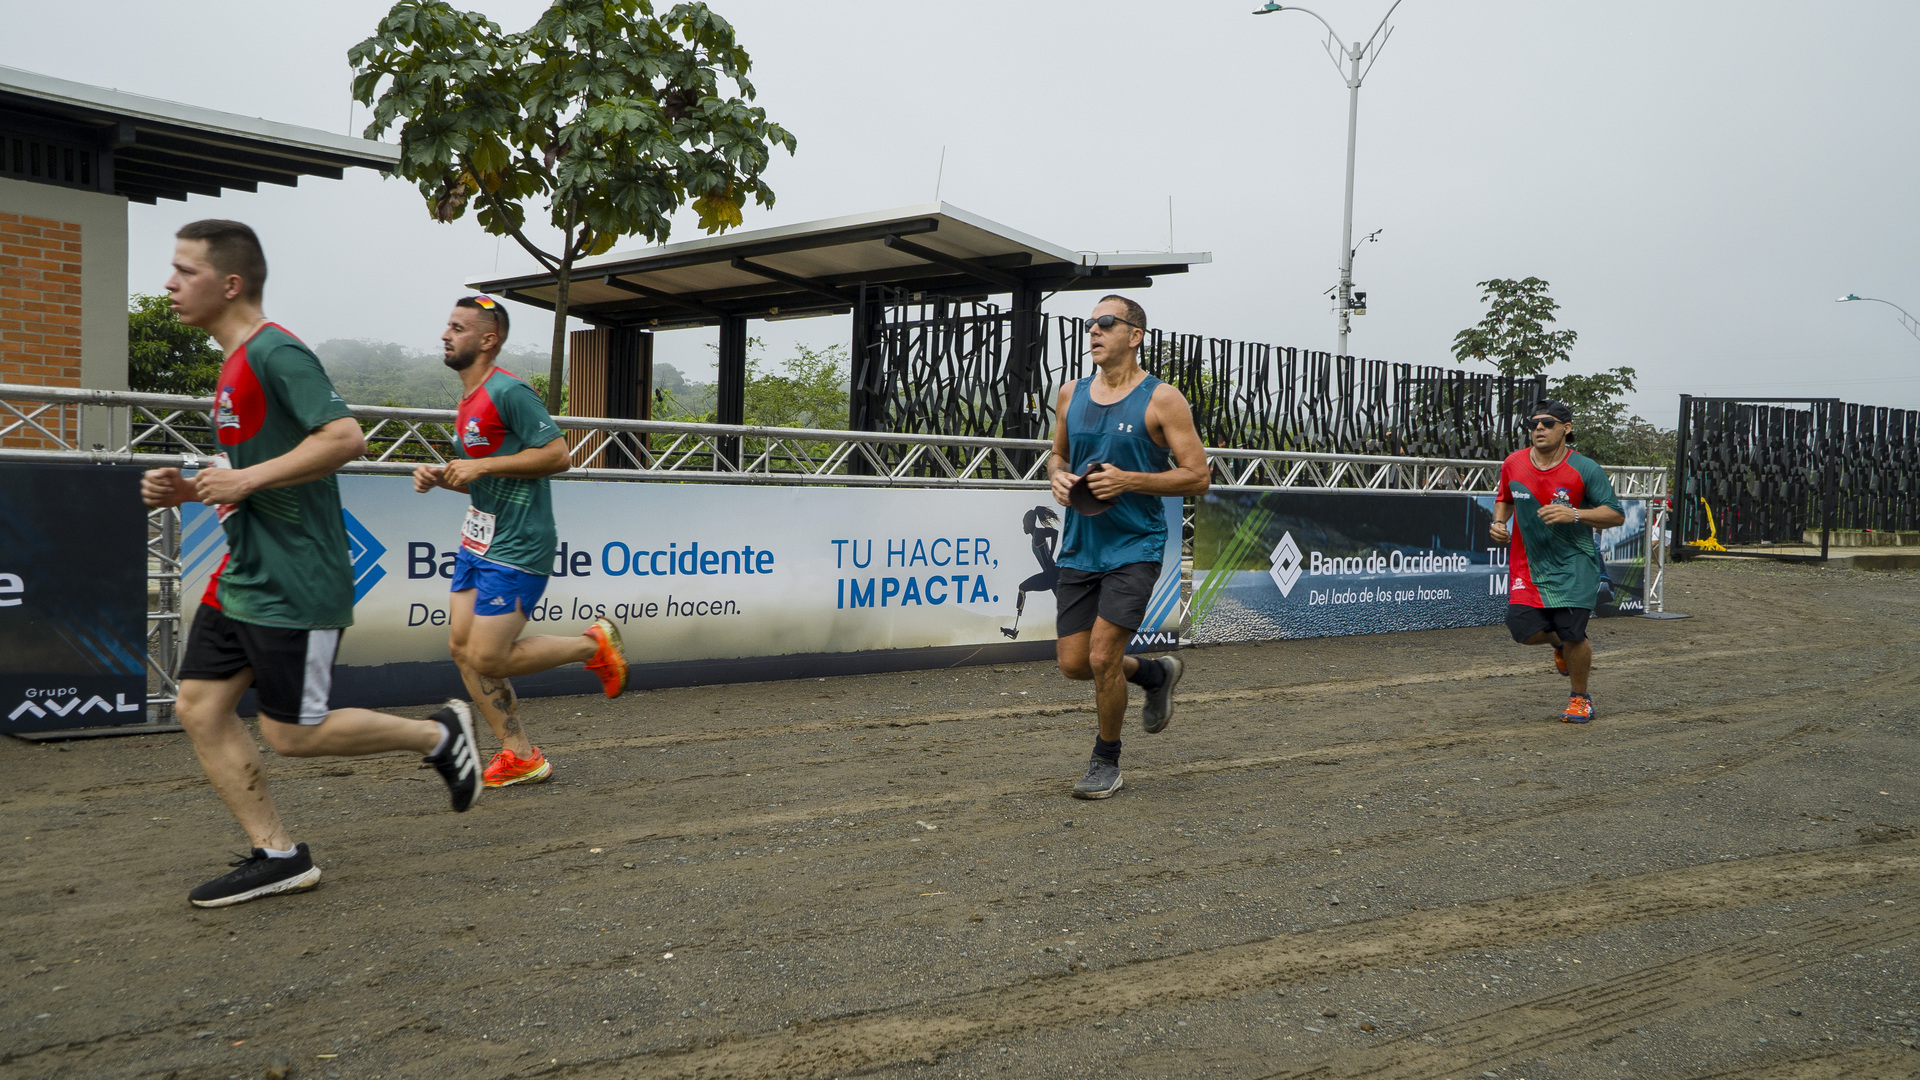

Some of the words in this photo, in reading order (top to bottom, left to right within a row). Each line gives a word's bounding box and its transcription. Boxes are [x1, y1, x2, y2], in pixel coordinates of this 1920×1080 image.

[601, 541, 775, 576] Occidente
[831, 539, 872, 569] TU
[888, 538, 999, 569] HACER,
[1310, 551, 1363, 576] Banco
[1366, 550, 1387, 574] de
[1390, 550, 1467, 574] Occidente
[1487, 547, 1507, 568] TU
[837, 574, 1000, 609] IMPACTA.
[1309, 588, 1328, 606] Del
[1331, 588, 1357, 605] lado
[1359, 587, 1374, 603] de
[1376, 586, 1392, 602] los
[1395, 590, 1414, 605] que
[1417, 585, 1452, 602] hacen.
[408, 602, 451, 627] De
[531, 597, 563, 622] de
[572, 596, 607, 621] los
[614, 602, 659, 625] que
[666, 594, 742, 617] hacen.
[1618, 600, 1644, 611] AVAL
[1130, 632, 1176, 646] AVAL
[25, 687, 78, 698] Grupo
[8, 693, 139, 721] AVAL
